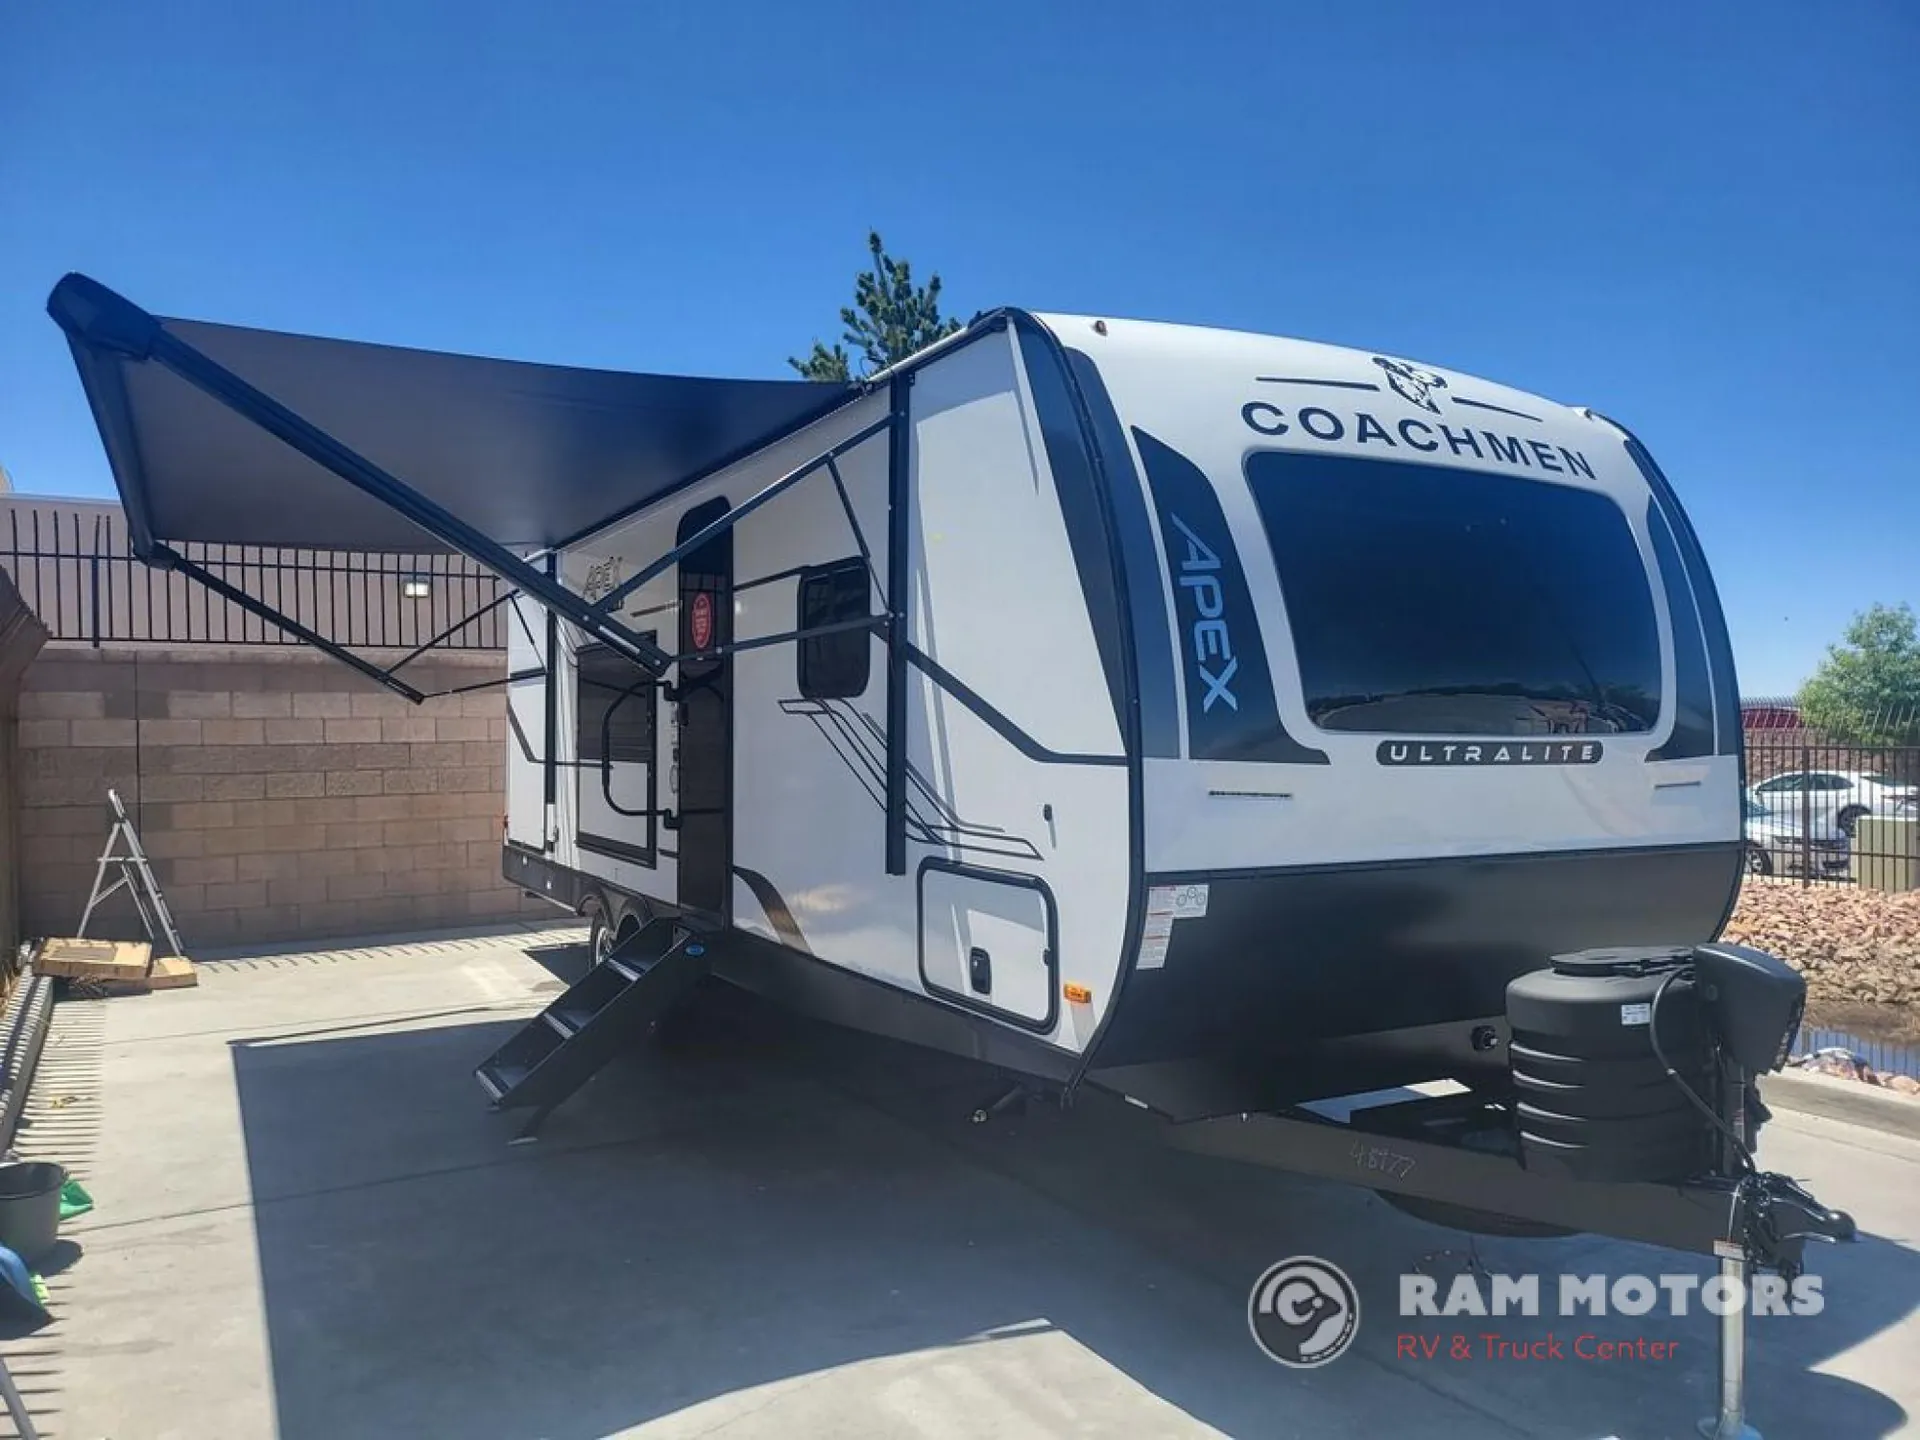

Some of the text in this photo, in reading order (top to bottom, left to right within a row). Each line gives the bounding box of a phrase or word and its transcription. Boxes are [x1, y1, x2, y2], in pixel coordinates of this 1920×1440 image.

[1240, 401, 1598, 480] COACHMEN
[1170, 512, 1240, 714] APEX
[1390, 743, 1595, 762] ULTRALITE
